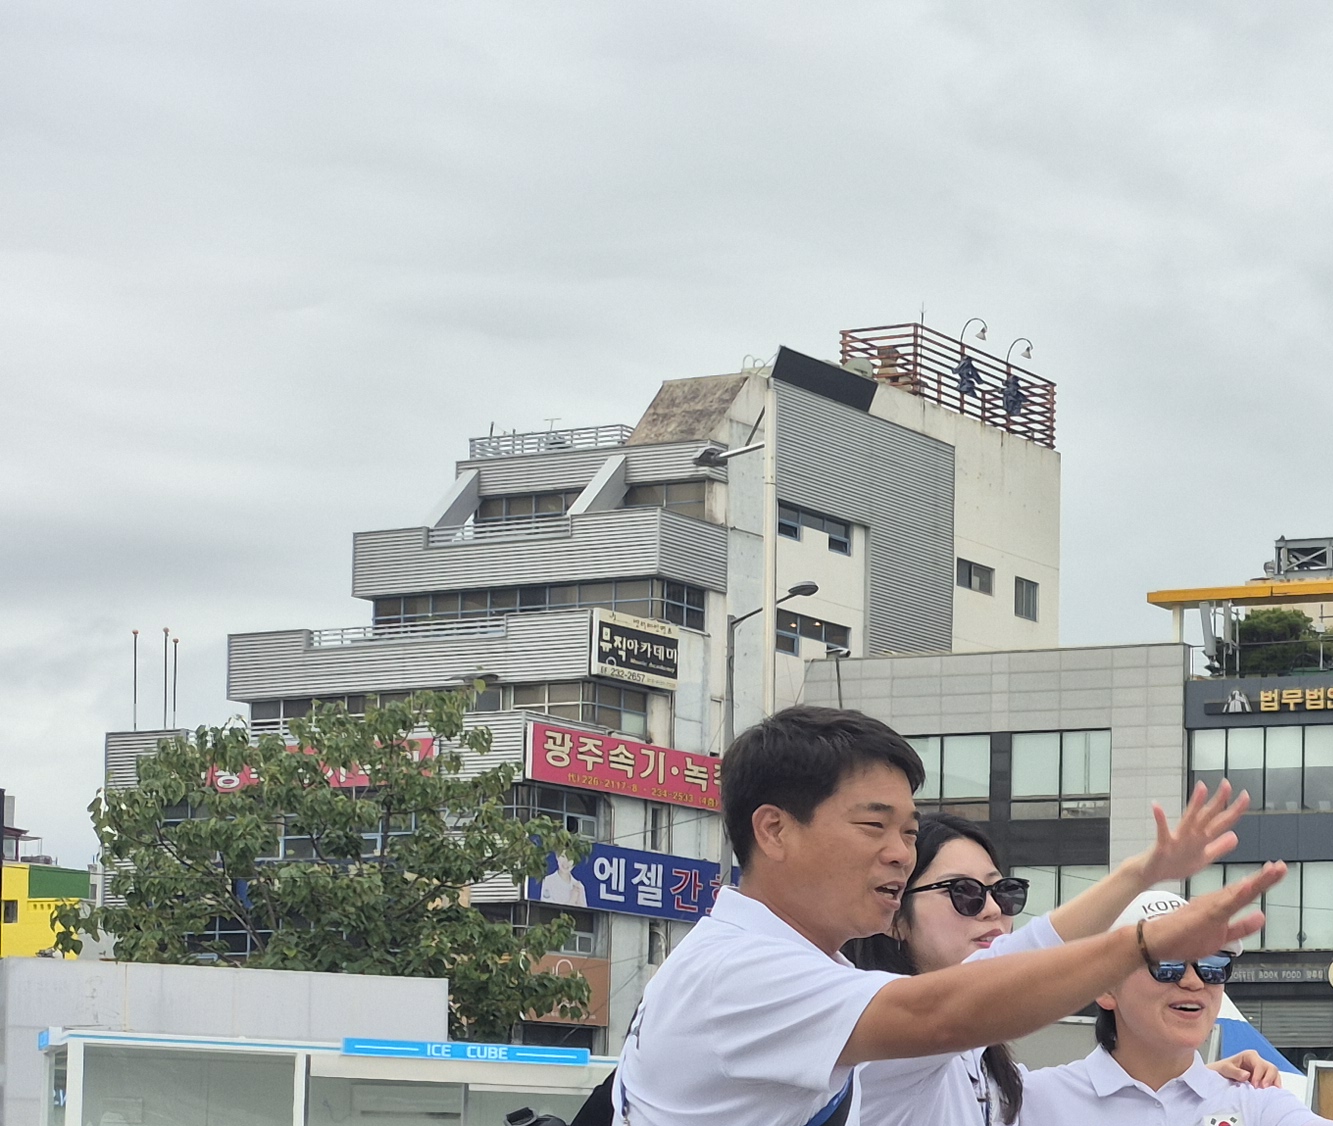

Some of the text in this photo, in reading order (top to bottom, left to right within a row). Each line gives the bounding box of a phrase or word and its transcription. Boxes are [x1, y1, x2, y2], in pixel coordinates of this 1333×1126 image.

[1142, 900, 1184, 914] KOR
[426, 1043, 508, 1060] ICE CUBE
